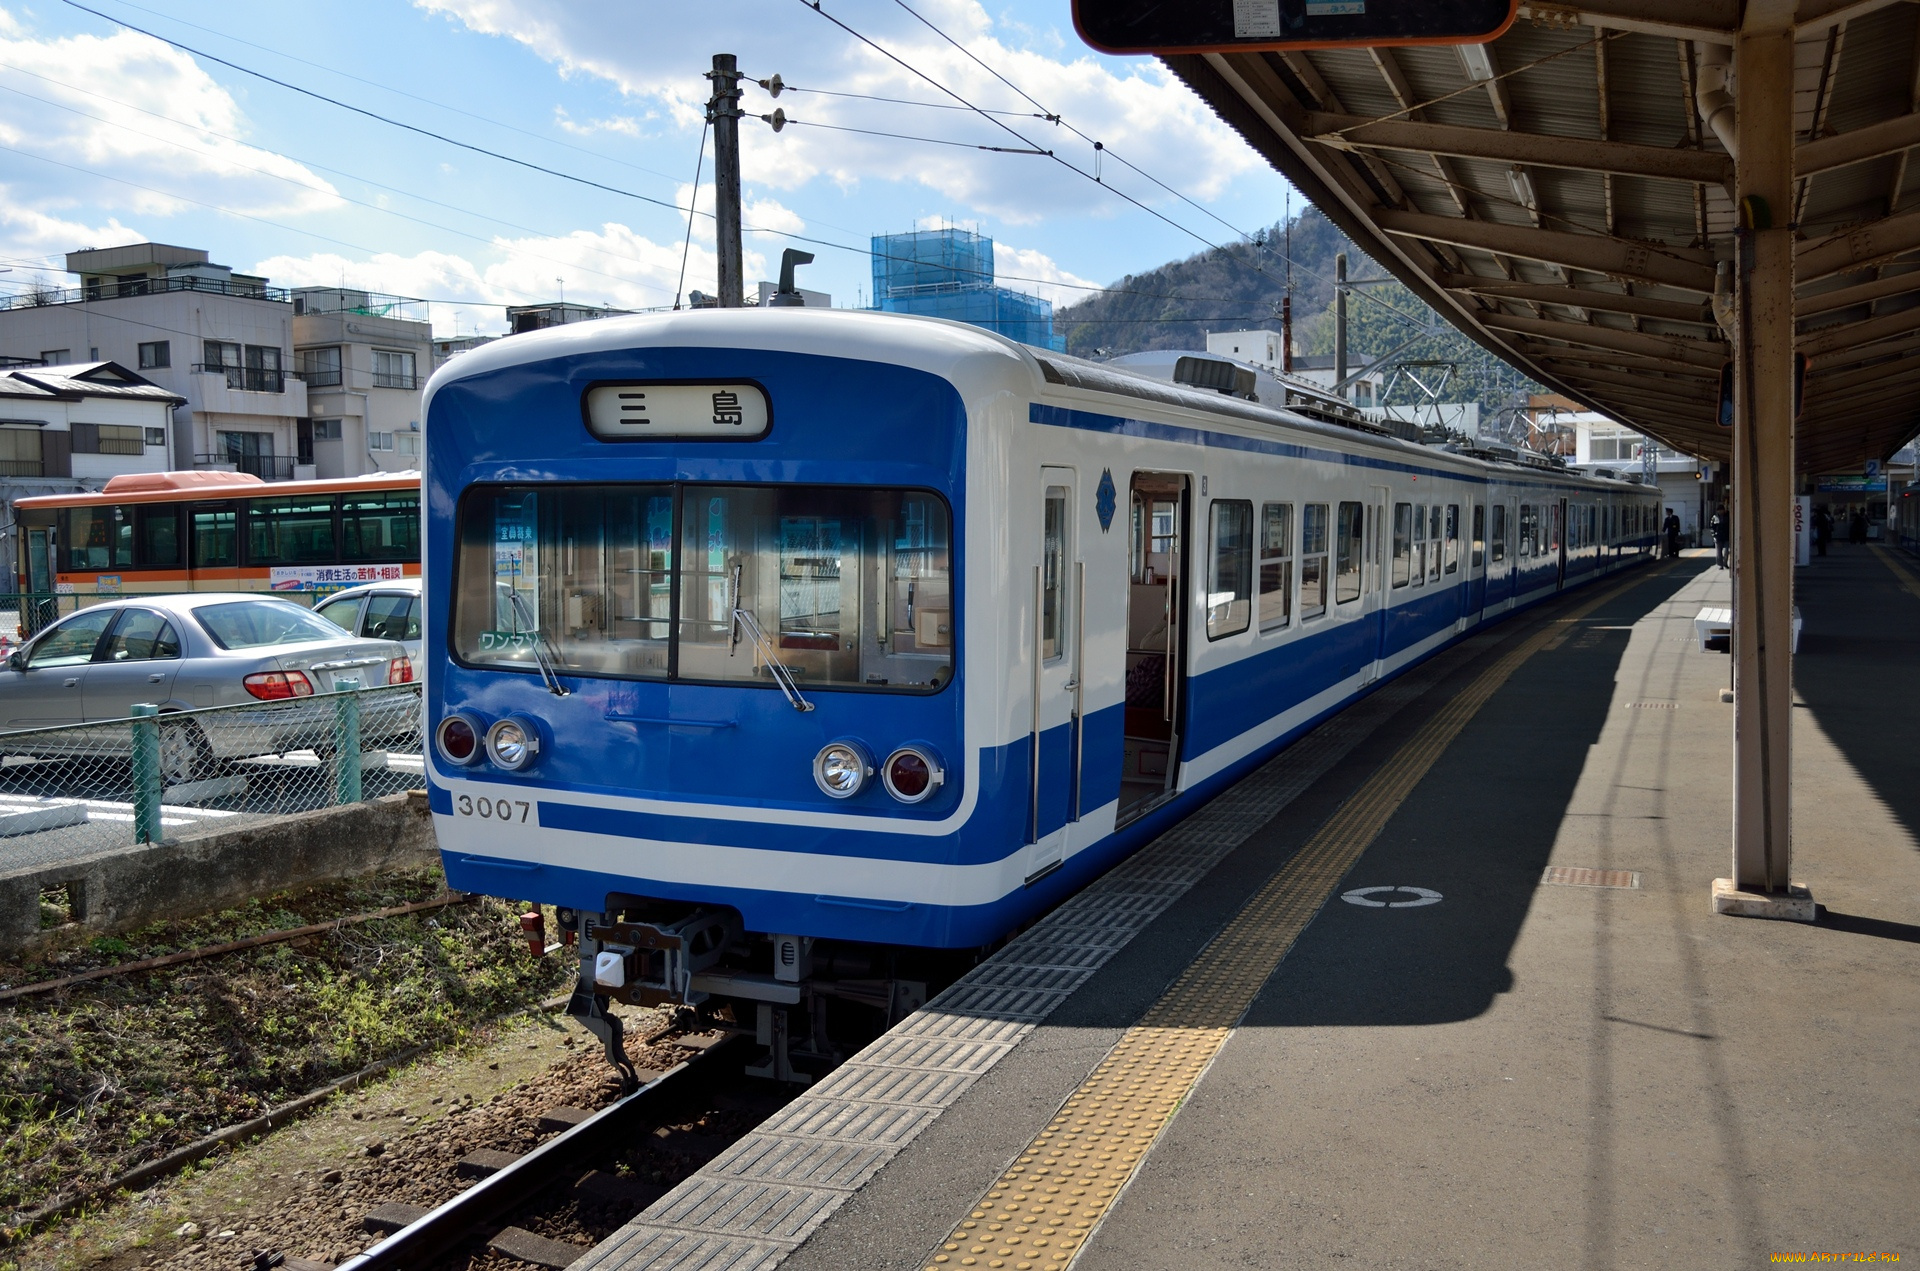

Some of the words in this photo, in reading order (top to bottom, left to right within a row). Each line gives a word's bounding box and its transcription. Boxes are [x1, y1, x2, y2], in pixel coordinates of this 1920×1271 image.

[618, 390, 742, 426] 三島
[1702, 466, 1708, 480] 1
[1867, 461, 1877, 476] 2
[316, 567, 400, 581] 消費生活の苦情・相談
[458, 794, 530, 823] 3007
